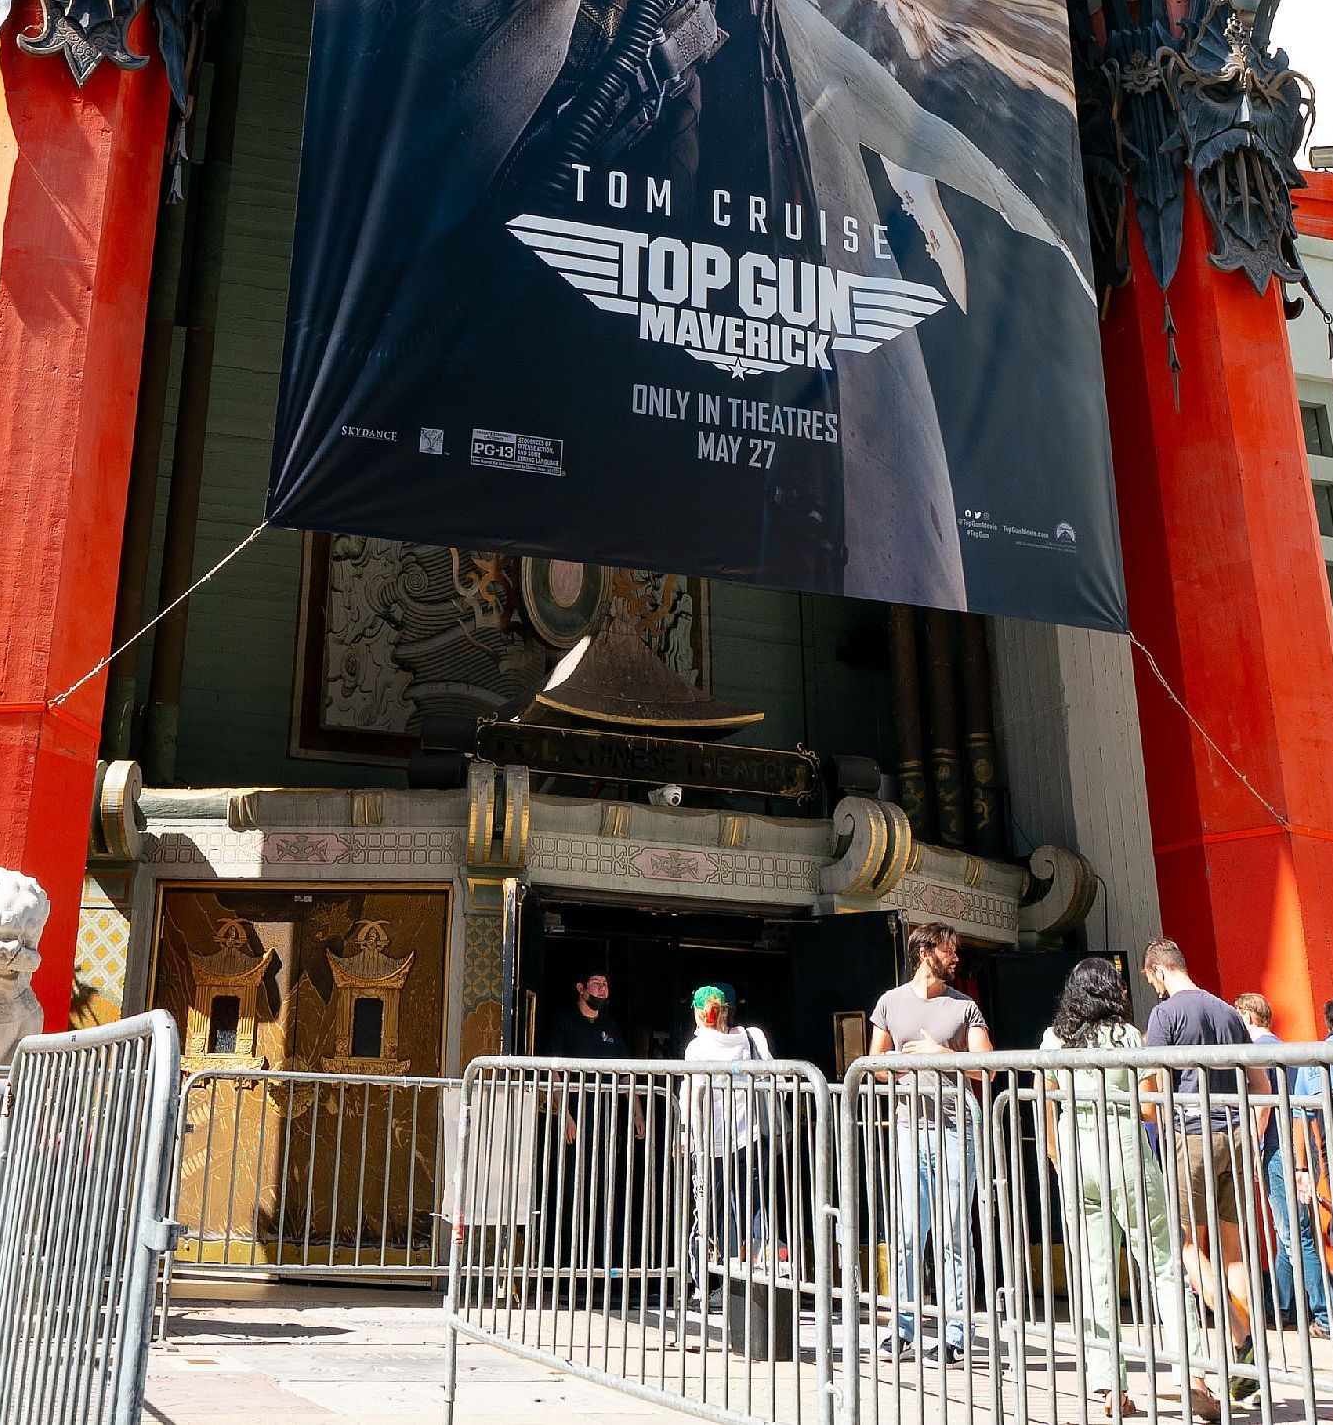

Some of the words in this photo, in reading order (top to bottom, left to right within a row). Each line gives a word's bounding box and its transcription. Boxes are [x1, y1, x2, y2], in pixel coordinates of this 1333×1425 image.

[570, 163, 672, 217] TOM
[713, 188, 893, 260] CRUISE
[617, 231, 731, 310] TOP
[737, 250, 856, 337] GUN
[638, 301, 833, 371] MAVERICK
[340, 425, 398, 442] SKYDANCE
[631, 383, 691, 421] ONLY
[697, 392, 721, 426] IN
[727, 397, 839, 444] THEATRES
[473, 442, 514, 459] PG-13
[697, 431, 743, 465] MAY
[748, 438, 777, 470] 27
